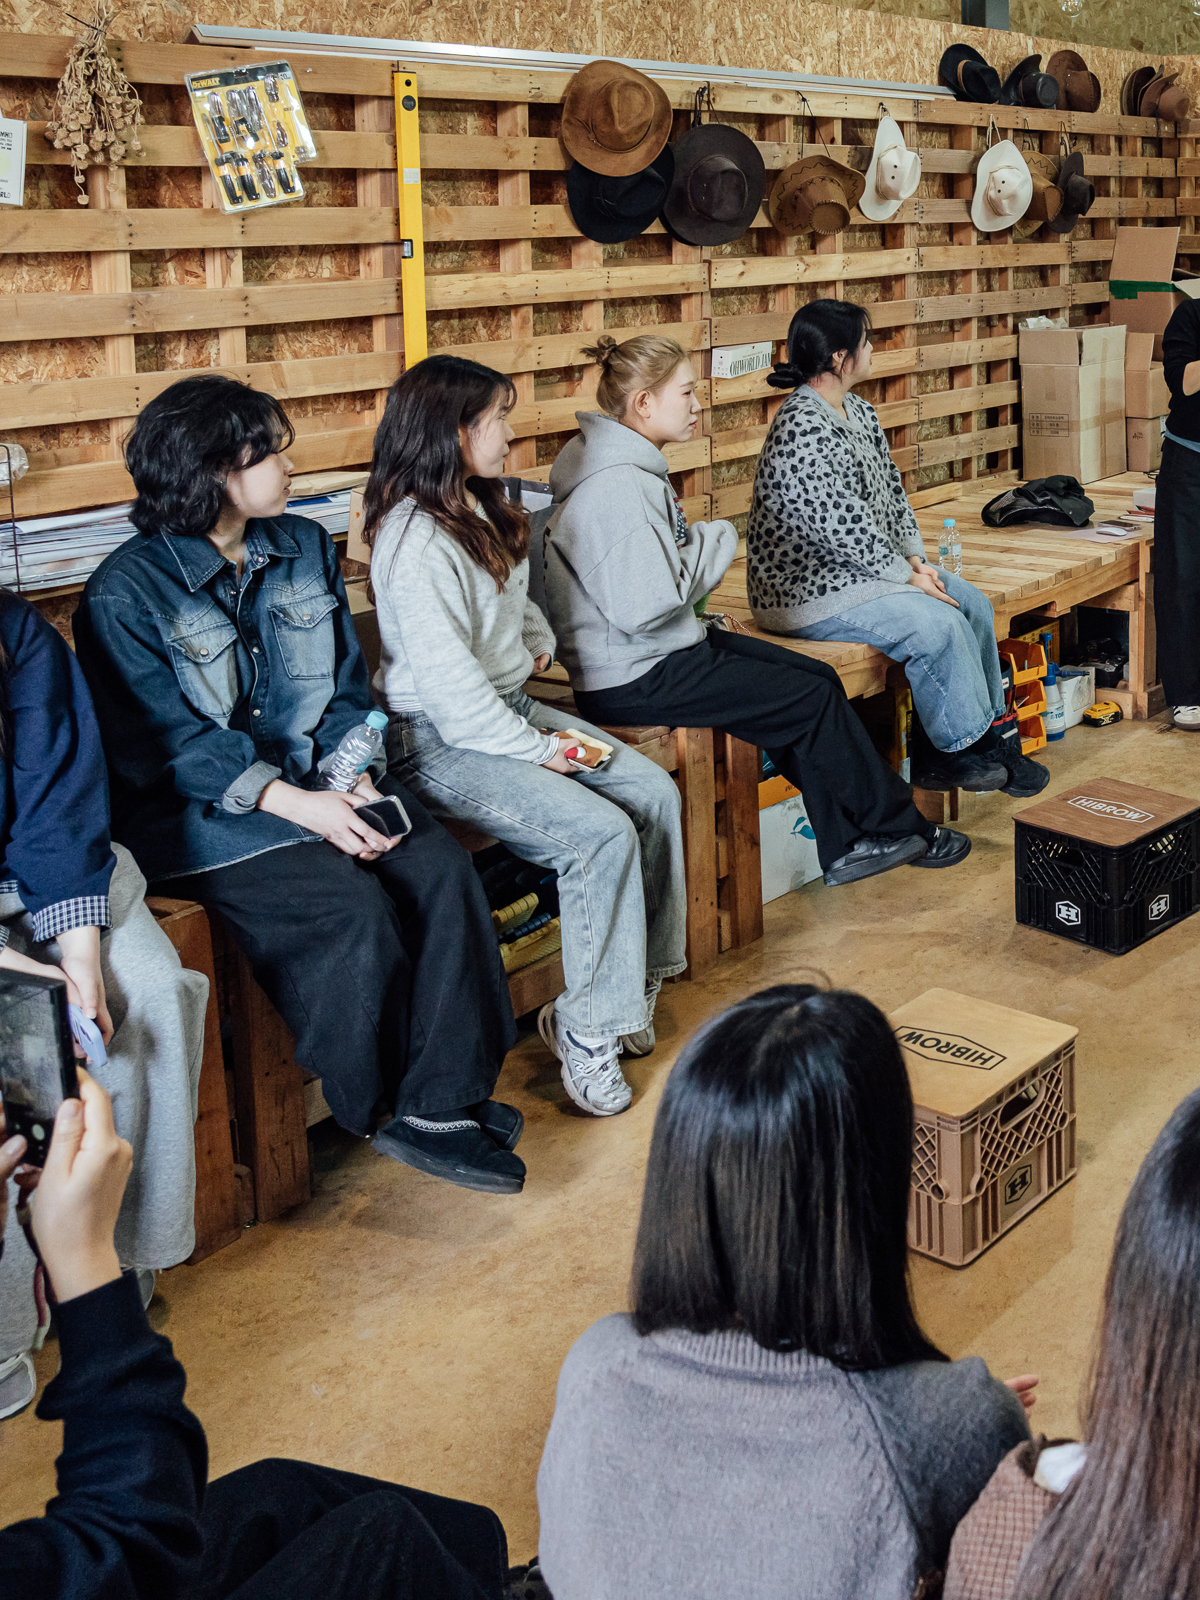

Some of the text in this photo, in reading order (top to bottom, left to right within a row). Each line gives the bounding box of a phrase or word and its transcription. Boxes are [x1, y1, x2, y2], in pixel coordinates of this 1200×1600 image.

[1075, 798, 1146, 821] HIBROW
[1058, 904, 1078, 922] H
[1151, 897, 1167, 917] H
[899, 1030, 996, 1067] HIBROW
[1007, 1171, 1030, 1200] H
